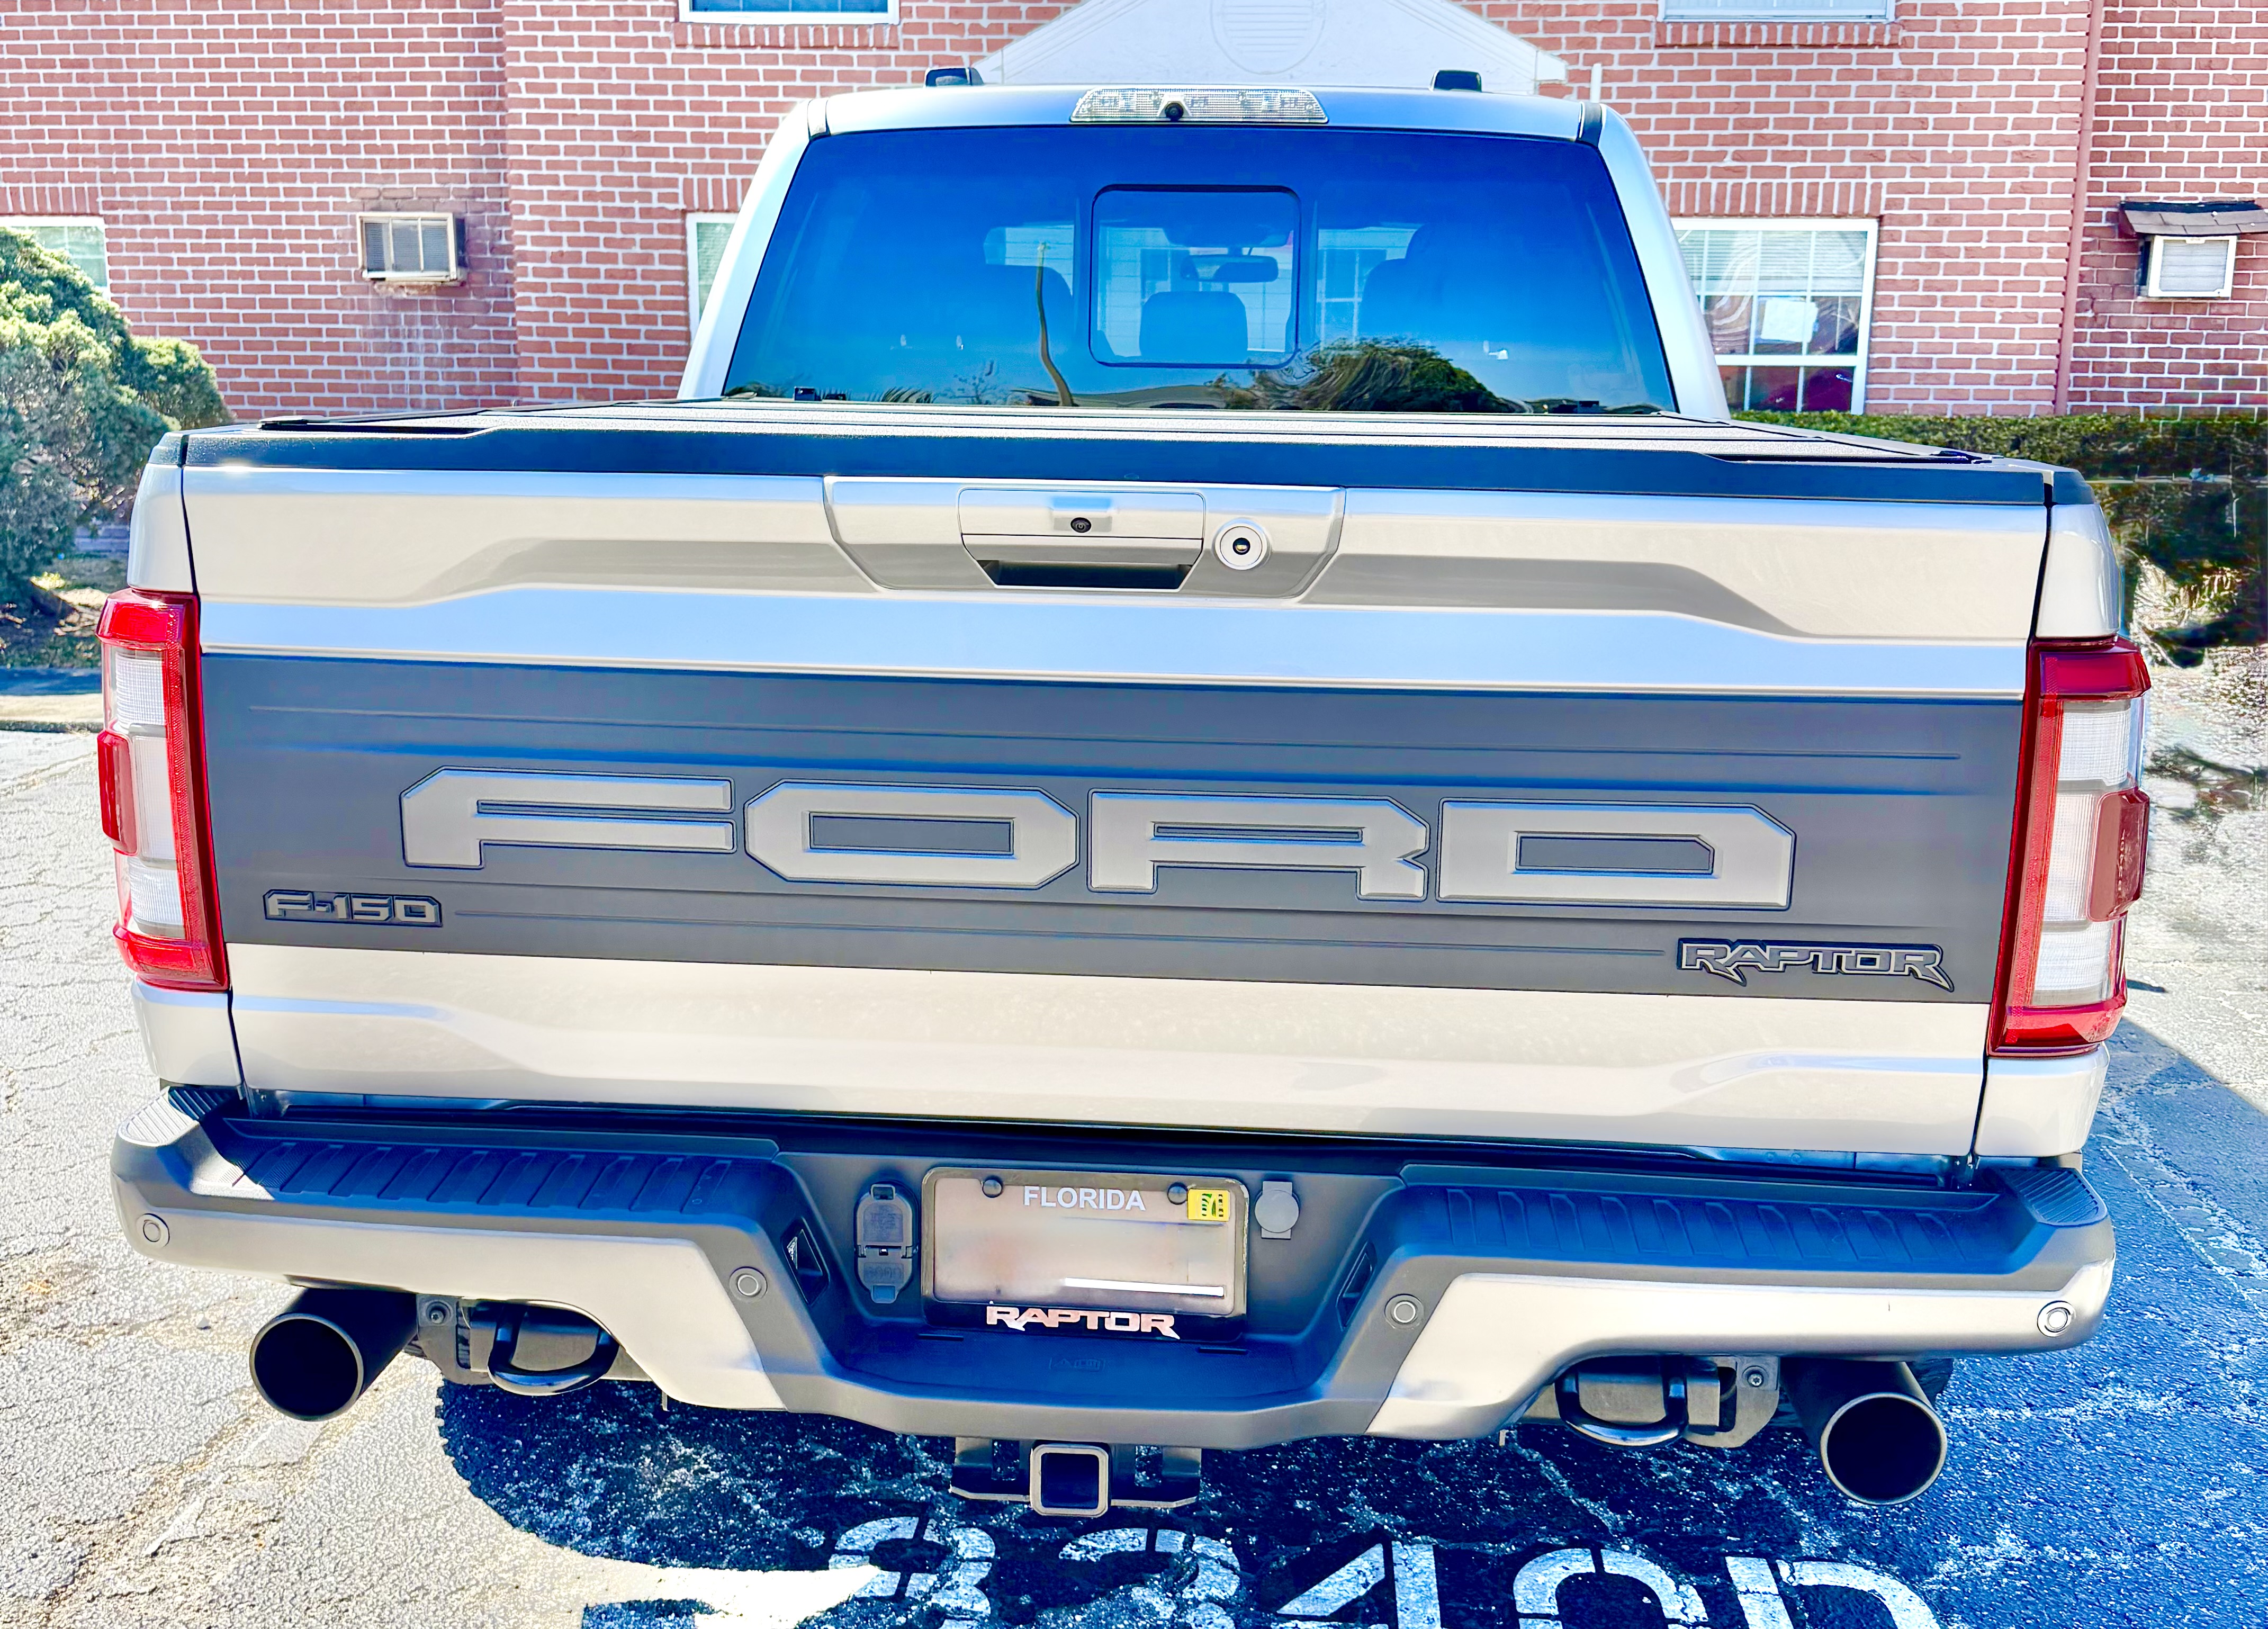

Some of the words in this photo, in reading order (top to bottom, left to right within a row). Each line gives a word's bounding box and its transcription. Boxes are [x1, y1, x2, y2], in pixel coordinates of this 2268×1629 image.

[401, 766, 1795, 911] FORD
[263, 889, 443, 926] F-150
[1678, 938, 1954, 992] RAPTOR
[1024, 1185, 1146, 1211] FLORIDA
[986, 1306, 1181, 1340] RAPTOR
